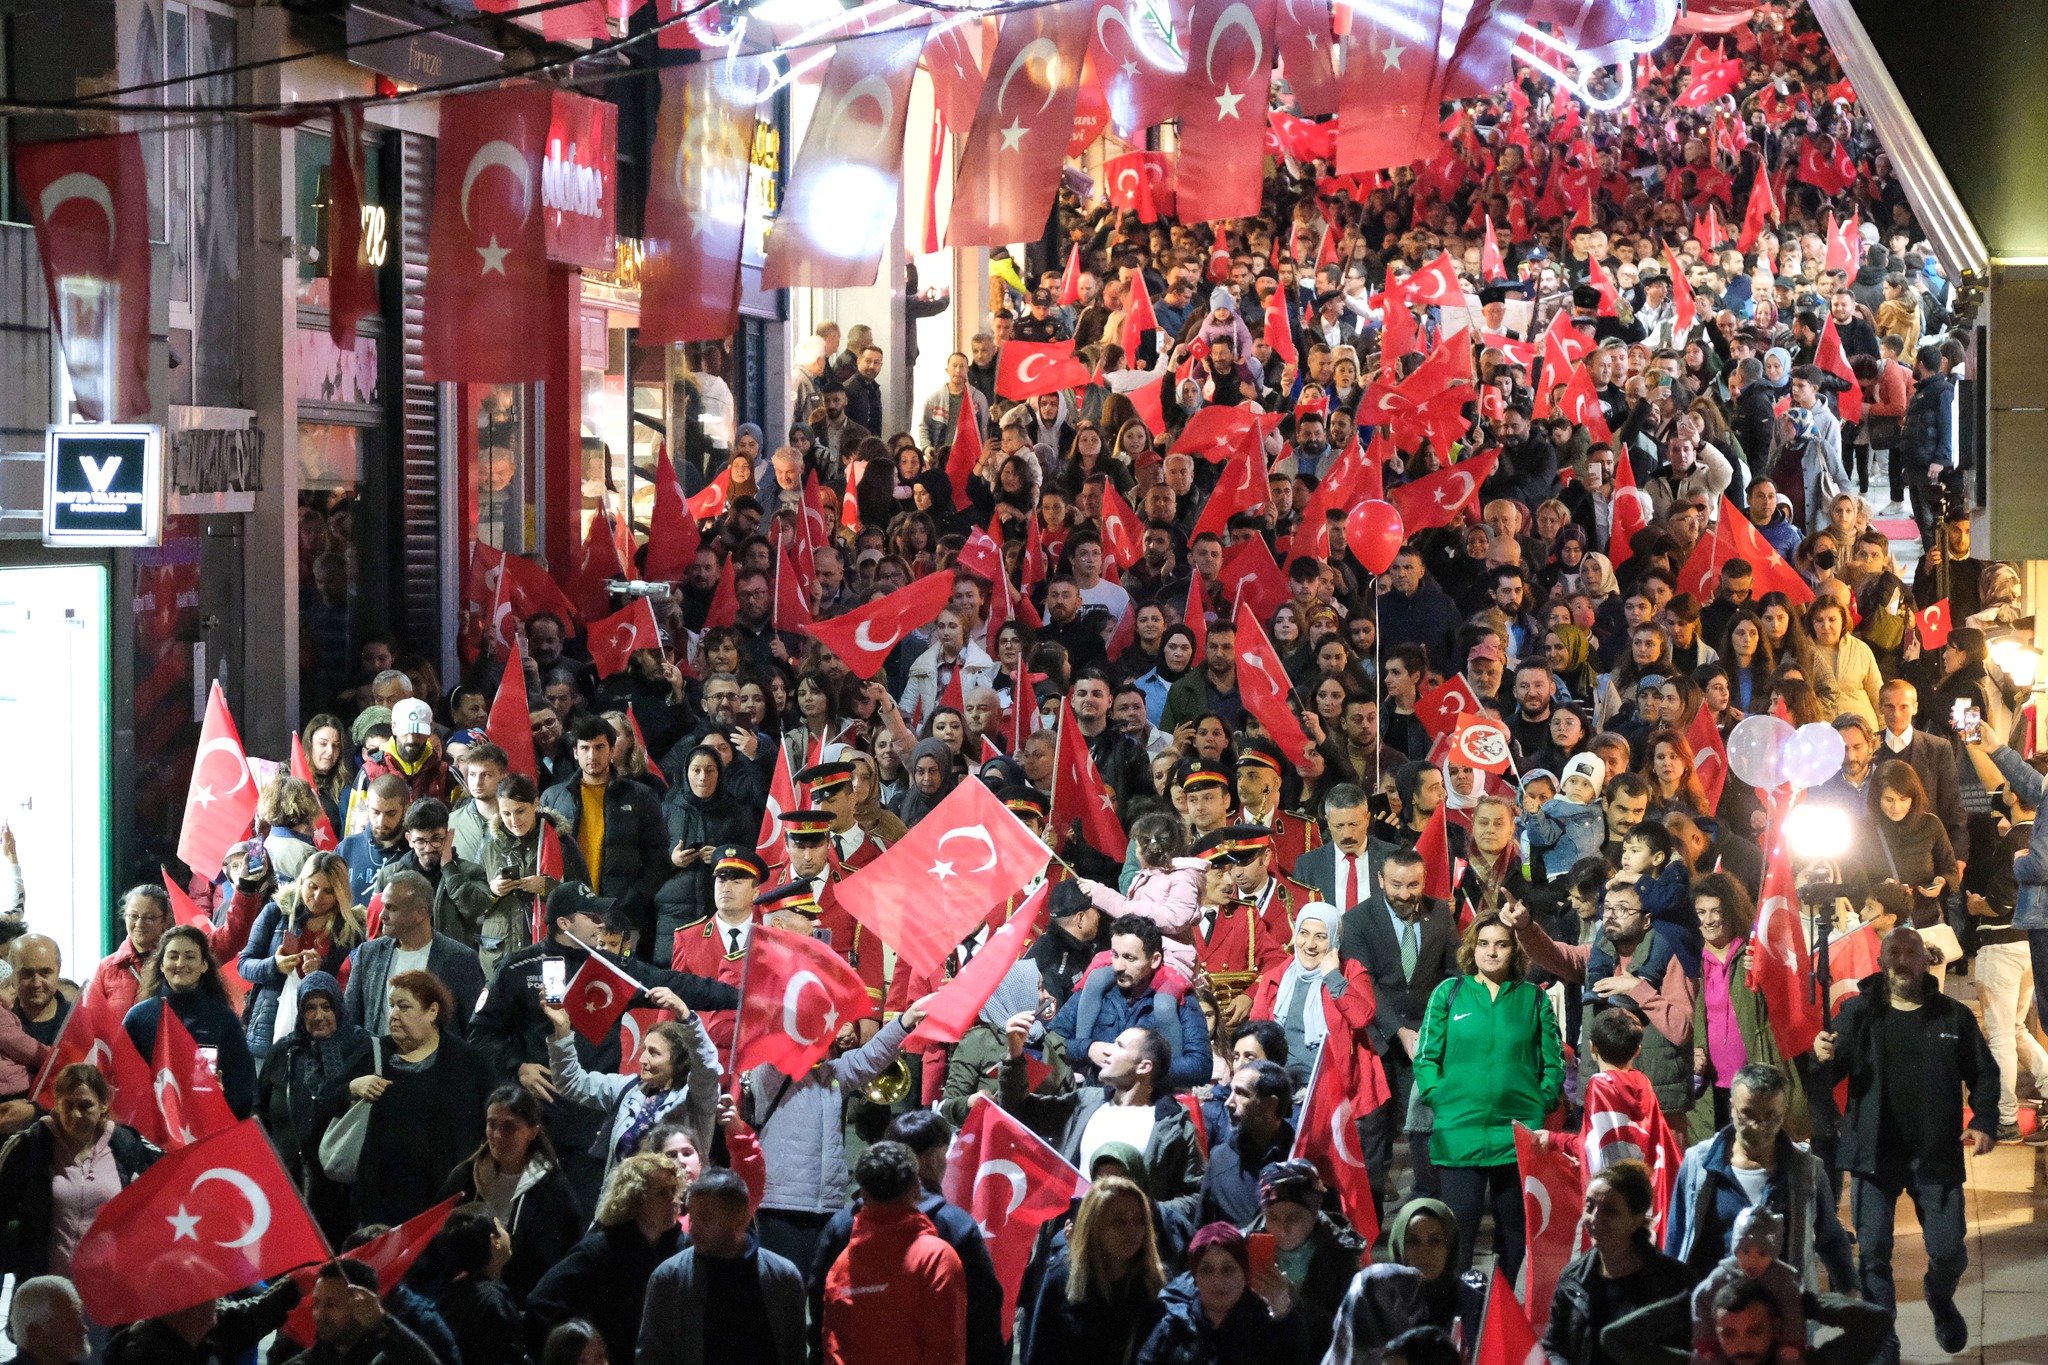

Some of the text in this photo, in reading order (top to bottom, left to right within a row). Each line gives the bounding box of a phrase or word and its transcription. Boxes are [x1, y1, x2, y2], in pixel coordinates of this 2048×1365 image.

[408, 39, 442, 77] firuze
[1073, 116, 1097, 126] ans
[1069, 128, 1085, 142] vi
[541, 138, 602, 218] odafone
